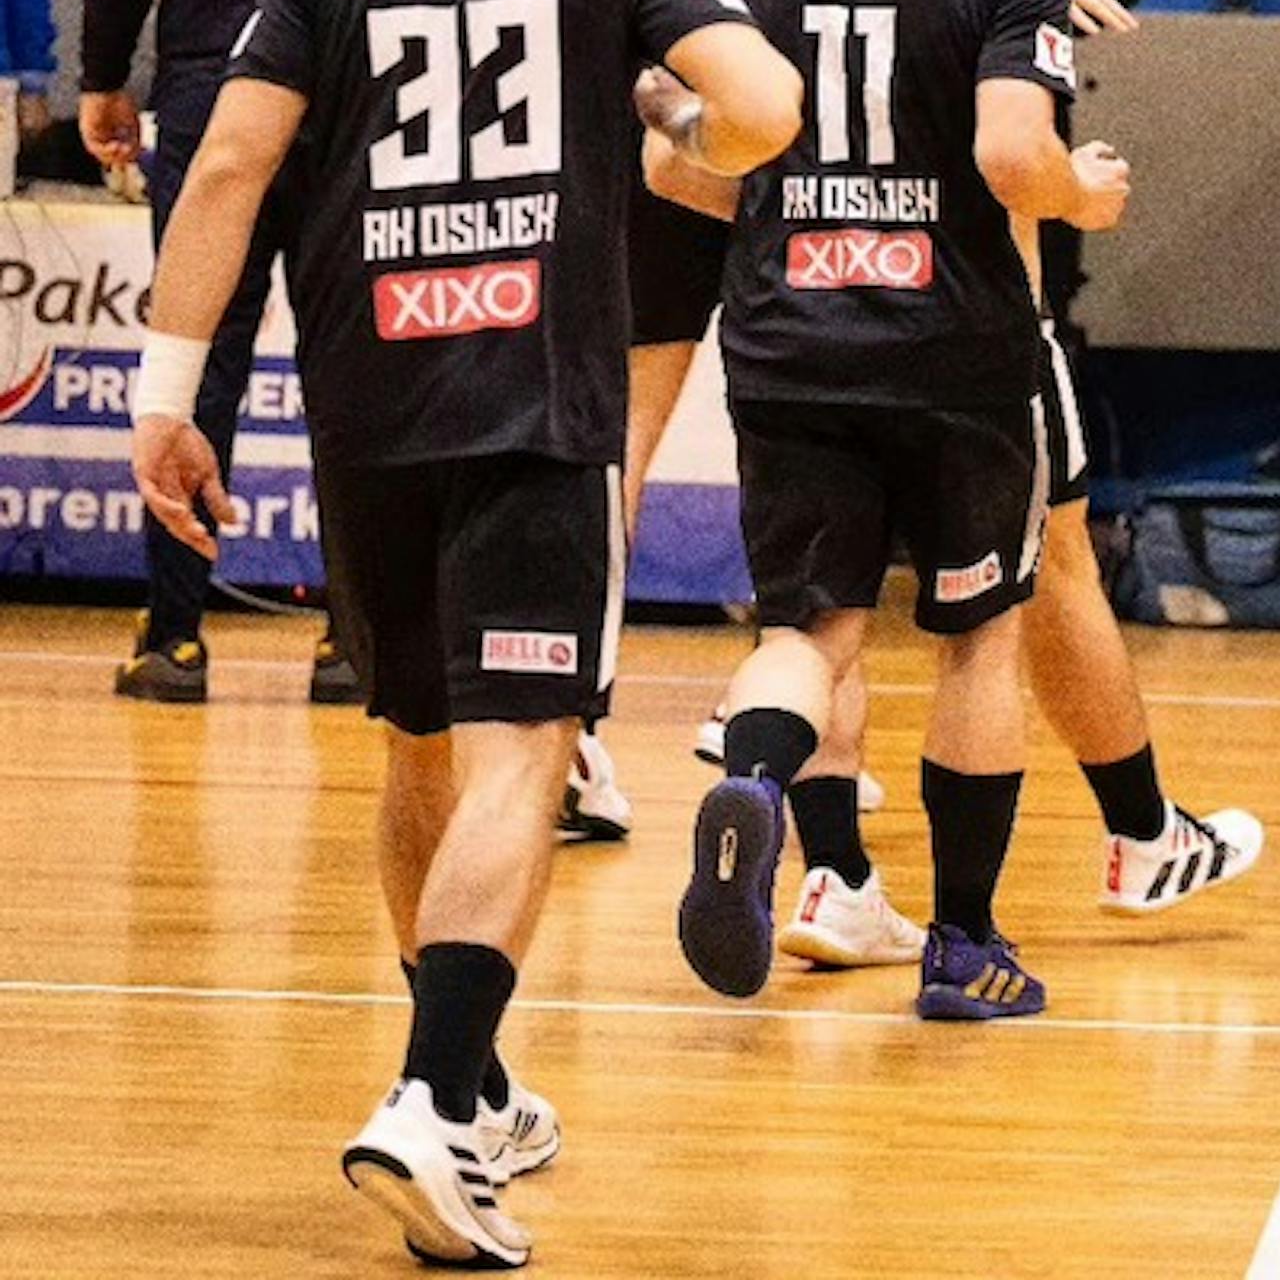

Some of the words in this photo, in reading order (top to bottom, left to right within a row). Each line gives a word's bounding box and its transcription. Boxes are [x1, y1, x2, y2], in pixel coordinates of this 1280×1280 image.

[802, 4, 898, 166] 11
[363, 205, 415, 261] RK
[418, 192, 560, 257] OSIJEK
[821, 176, 939, 222] OSIJEK
[803, 236, 923, 282] XIXO
[389, 270, 535, 332] XIXO
